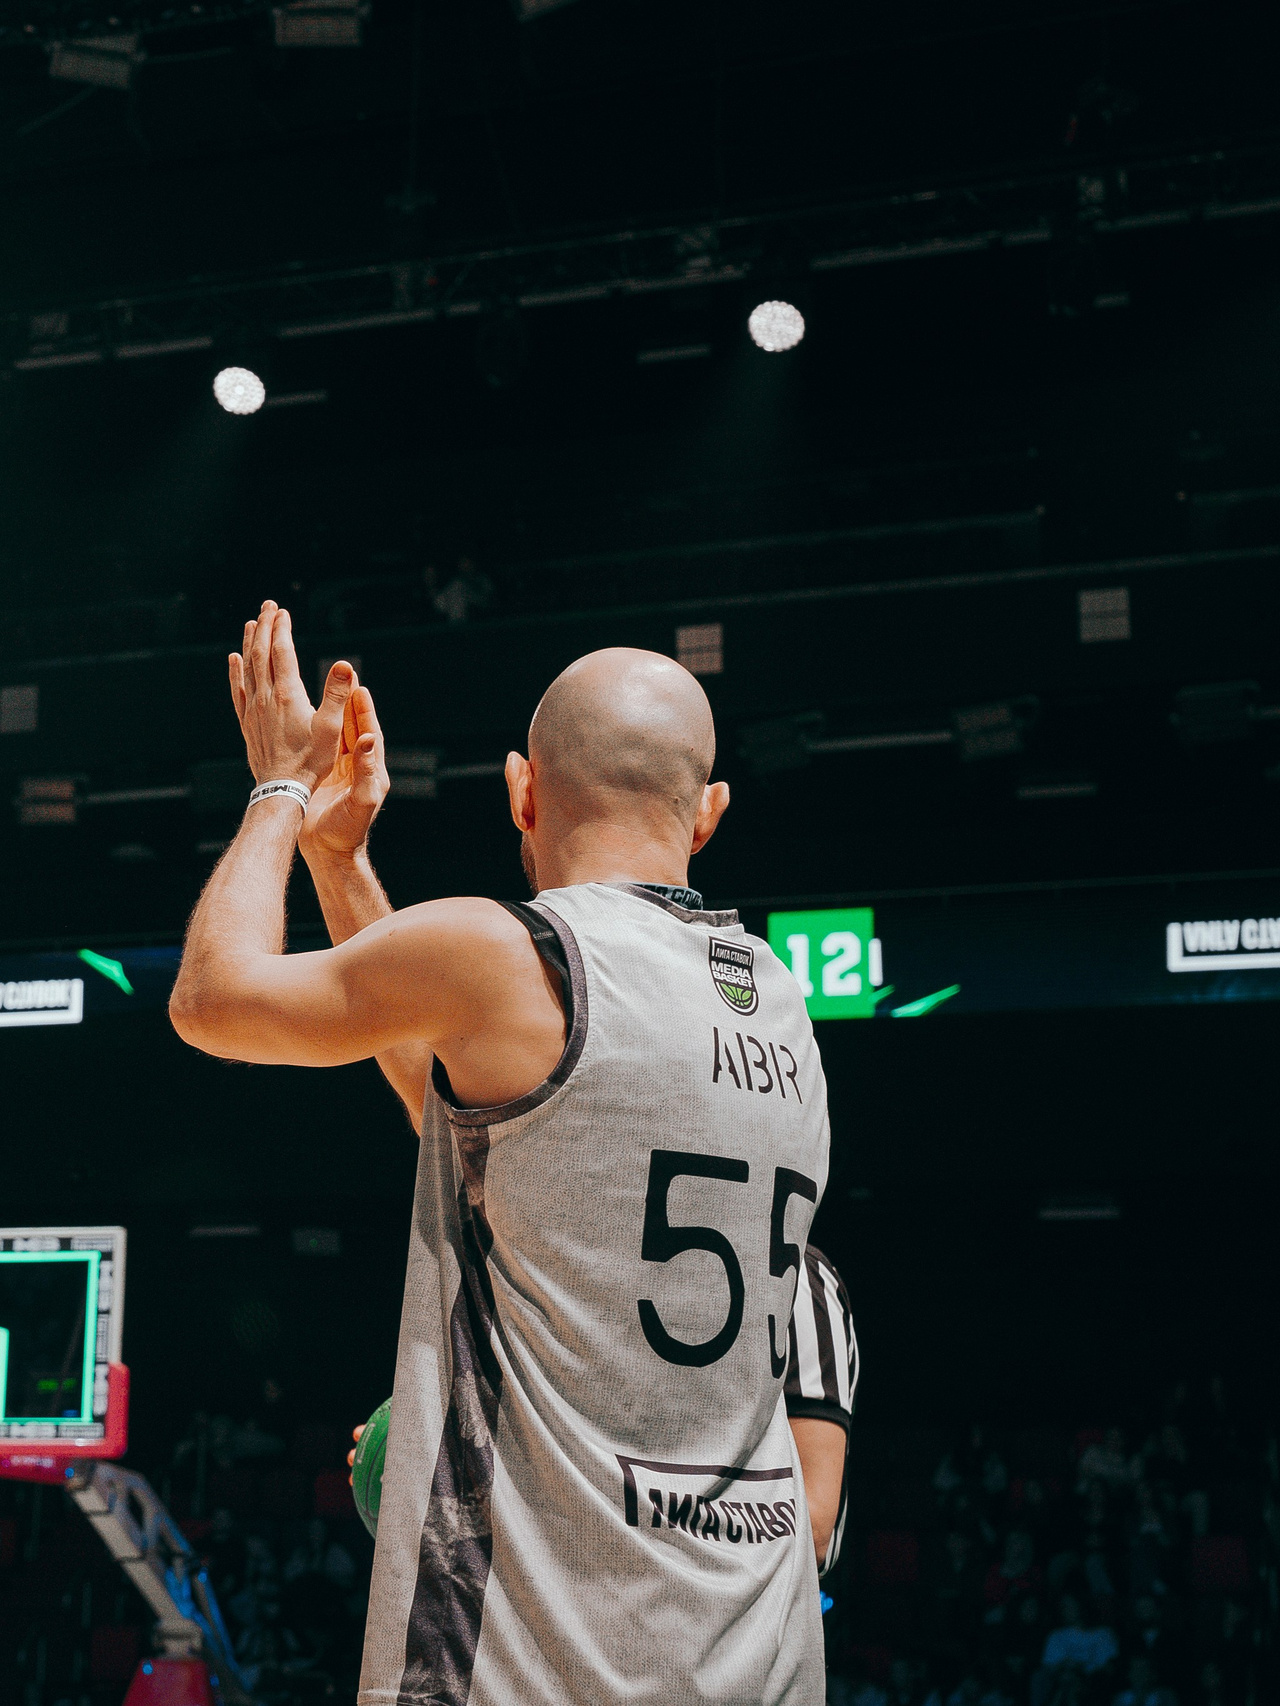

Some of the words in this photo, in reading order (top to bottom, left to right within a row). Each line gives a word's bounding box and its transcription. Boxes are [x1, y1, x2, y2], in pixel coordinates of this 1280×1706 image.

[711, 961, 752, 980] MEDIA
[712, 971, 753, 988] BASKET
[786, 931, 862, 998] 12
[637, 1149, 818, 1379] 55
[719, 1498, 796, 1544] СТАВО
